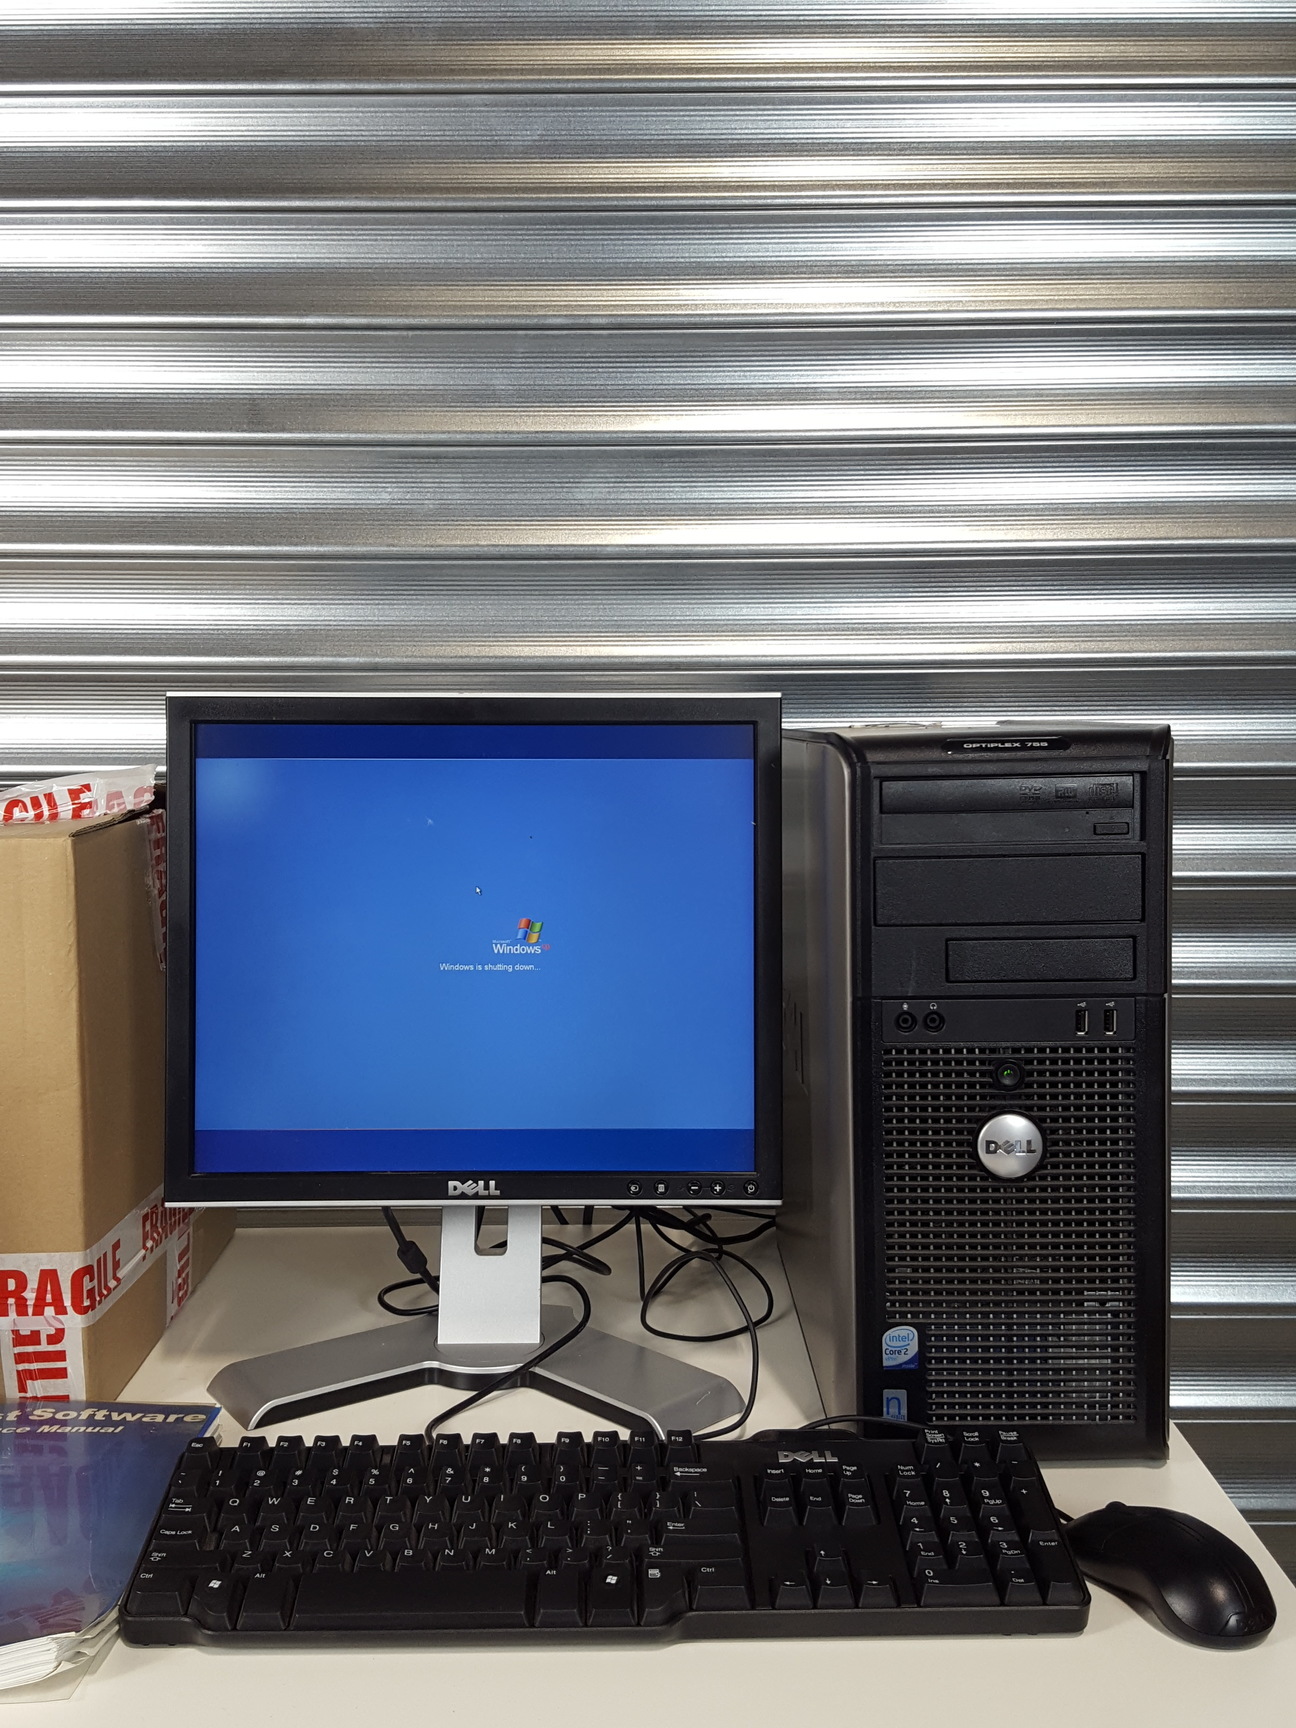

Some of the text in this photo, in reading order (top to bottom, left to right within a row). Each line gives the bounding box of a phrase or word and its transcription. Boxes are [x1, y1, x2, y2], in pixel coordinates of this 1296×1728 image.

[963, 741, 1021, 749] OPTIPLEX
[492, 944, 541, 954] Windows
[484, 964, 513, 972] shutting
[985, 1139, 1037, 1156] DELL
[447, 1180, 500, 1196] DELL
[888, 1334, 910, 1342] intel
[884, 1348, 902, 1356] Core
[29, 1408, 207, 1423] Software
[36, 1425, 124, 1433] Manual
[778, 1451, 838, 1462] DELL
